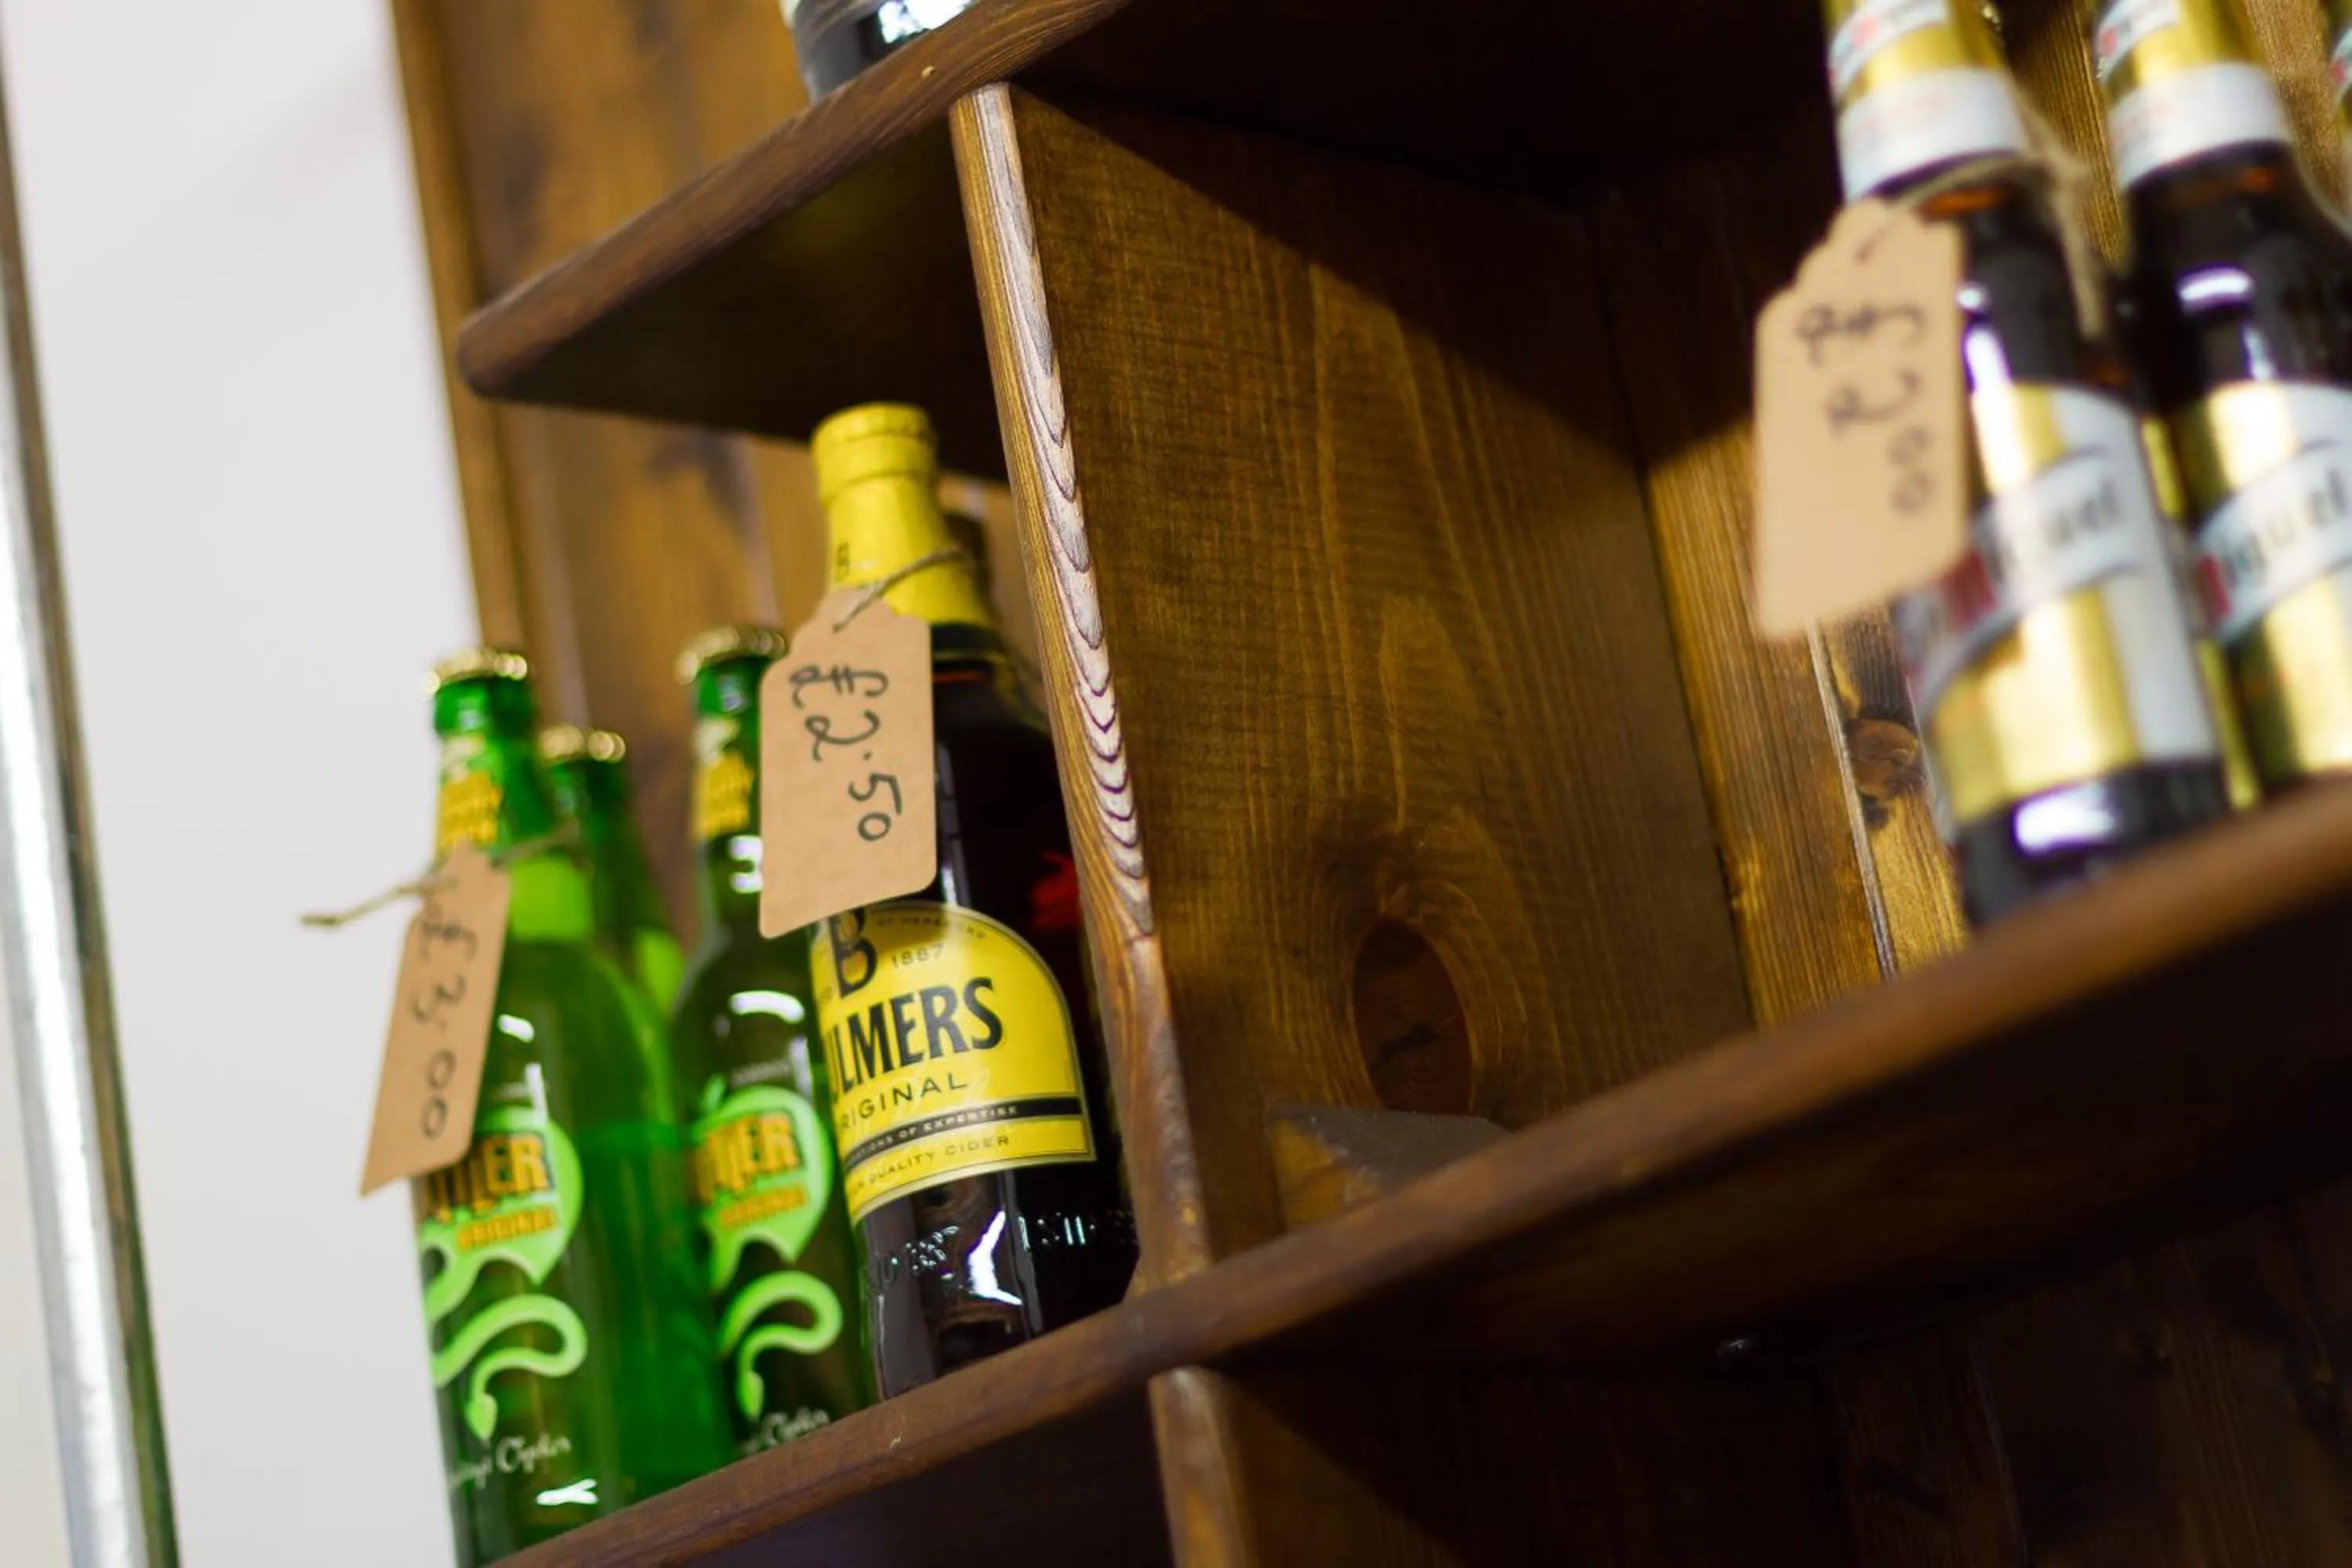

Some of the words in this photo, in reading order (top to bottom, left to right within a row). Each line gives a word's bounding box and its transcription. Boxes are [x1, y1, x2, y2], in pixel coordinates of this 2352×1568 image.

[789, 665, 902, 842] £2.50
[891, 942, 945, 968] 1887
[840, 1073, 968, 1129] RIGINAL
[869, 1151, 935, 1184] QUALITY
[945, 1135, 1010, 1156] CIDER
